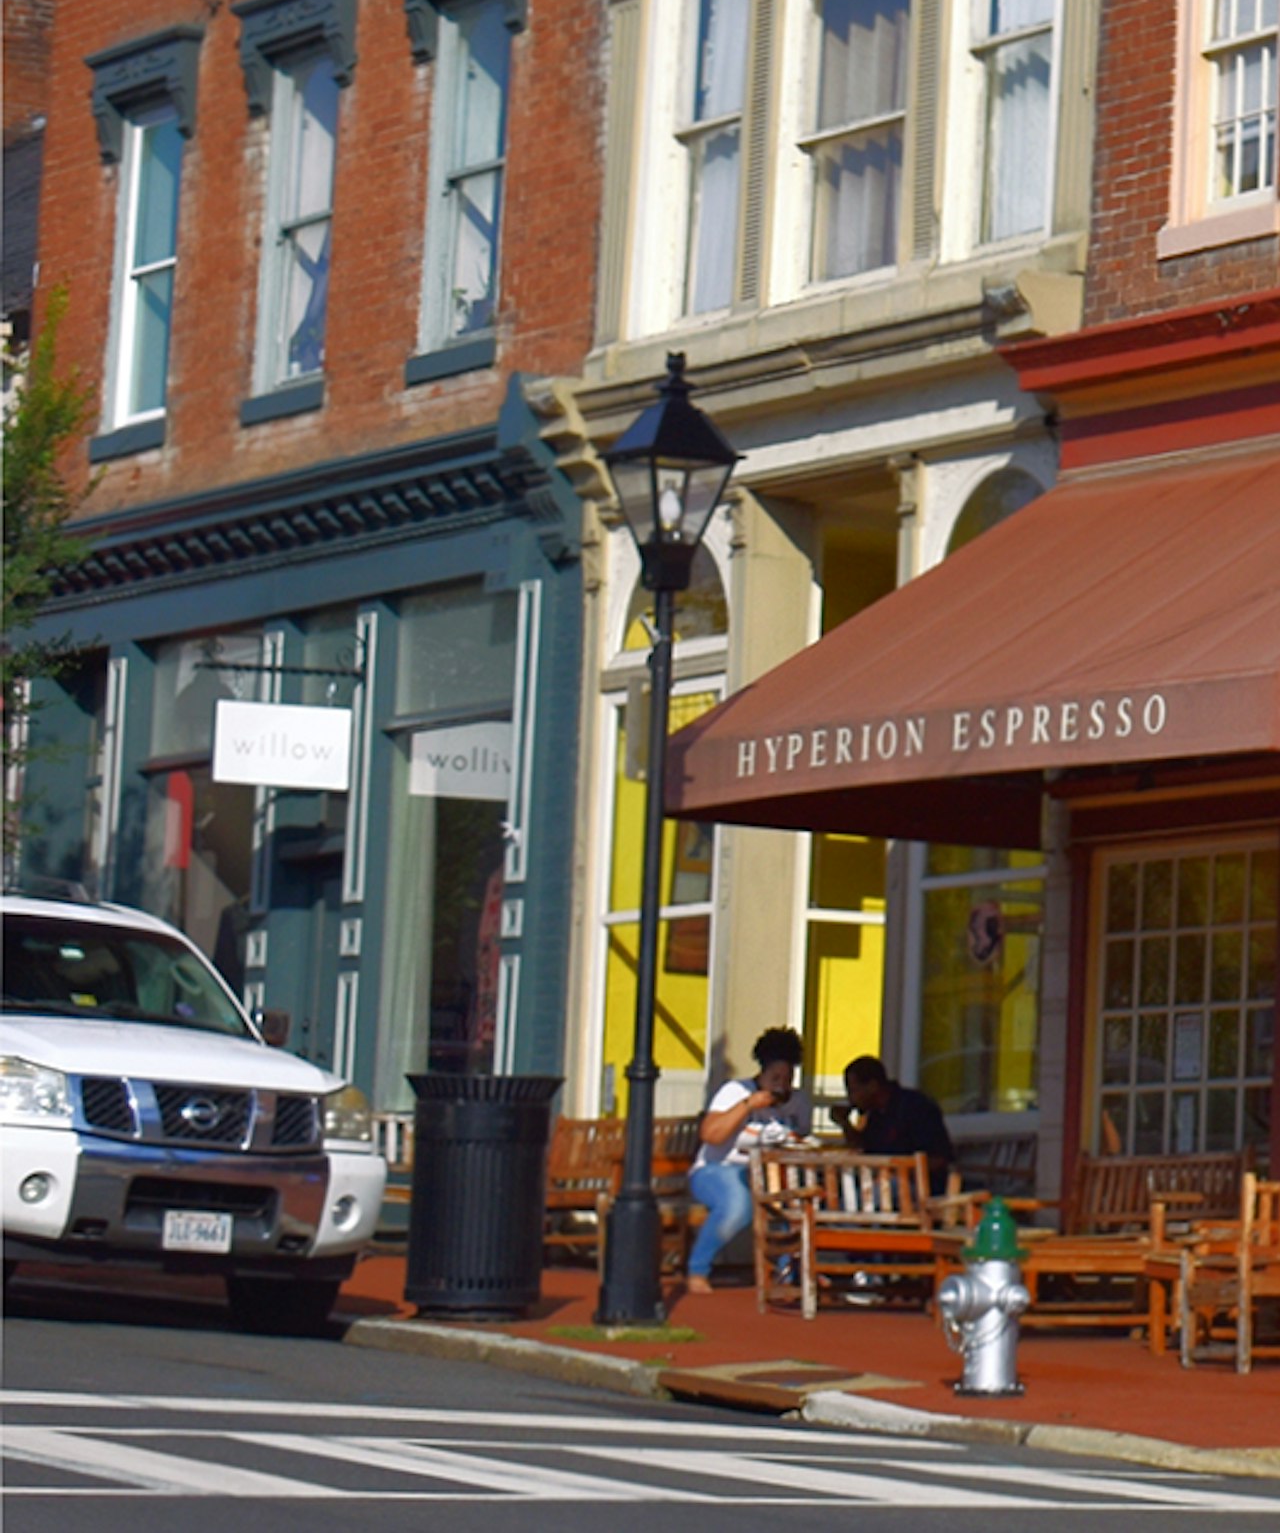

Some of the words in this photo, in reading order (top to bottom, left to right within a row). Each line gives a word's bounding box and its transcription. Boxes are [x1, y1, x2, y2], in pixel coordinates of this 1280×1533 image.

[232, 731, 334, 761] willow
[736, 716, 927, 778] HYPERION
[951, 693, 1168, 752] ESPRESSO
